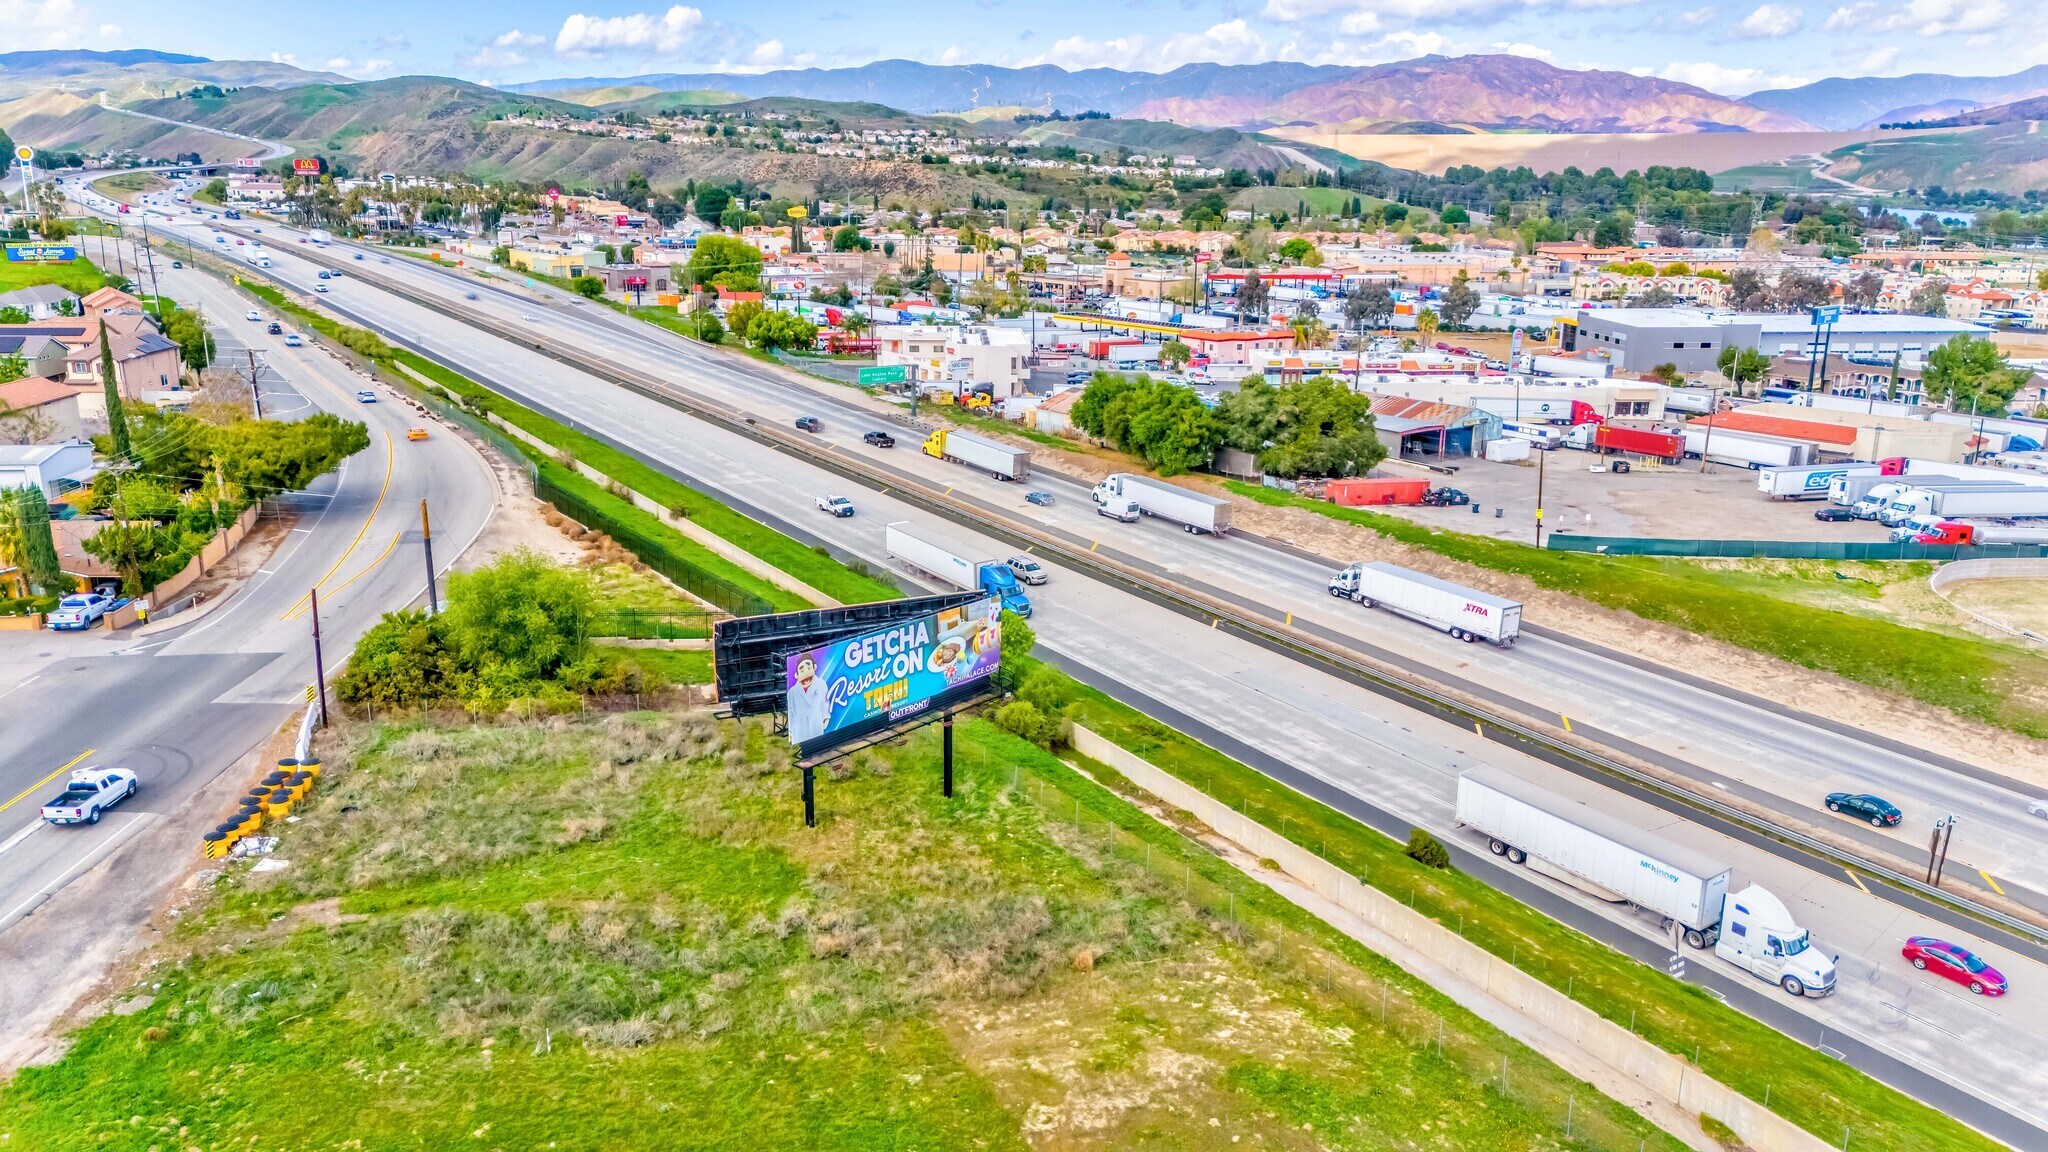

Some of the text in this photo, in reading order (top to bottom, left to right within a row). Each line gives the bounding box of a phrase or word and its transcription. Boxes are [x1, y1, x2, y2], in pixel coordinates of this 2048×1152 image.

[1462, 603, 1488, 617] XTRA
[844, 621, 930, 668] GETCHA
[892, 647, 923, 678] ON
[946, 661, 999, 687] TACHIPALACE.COM
[826, 657, 892, 714] Resort
[864, 709, 881, 719] CASINO
[890, 698, 929, 719] OUTFRONT
